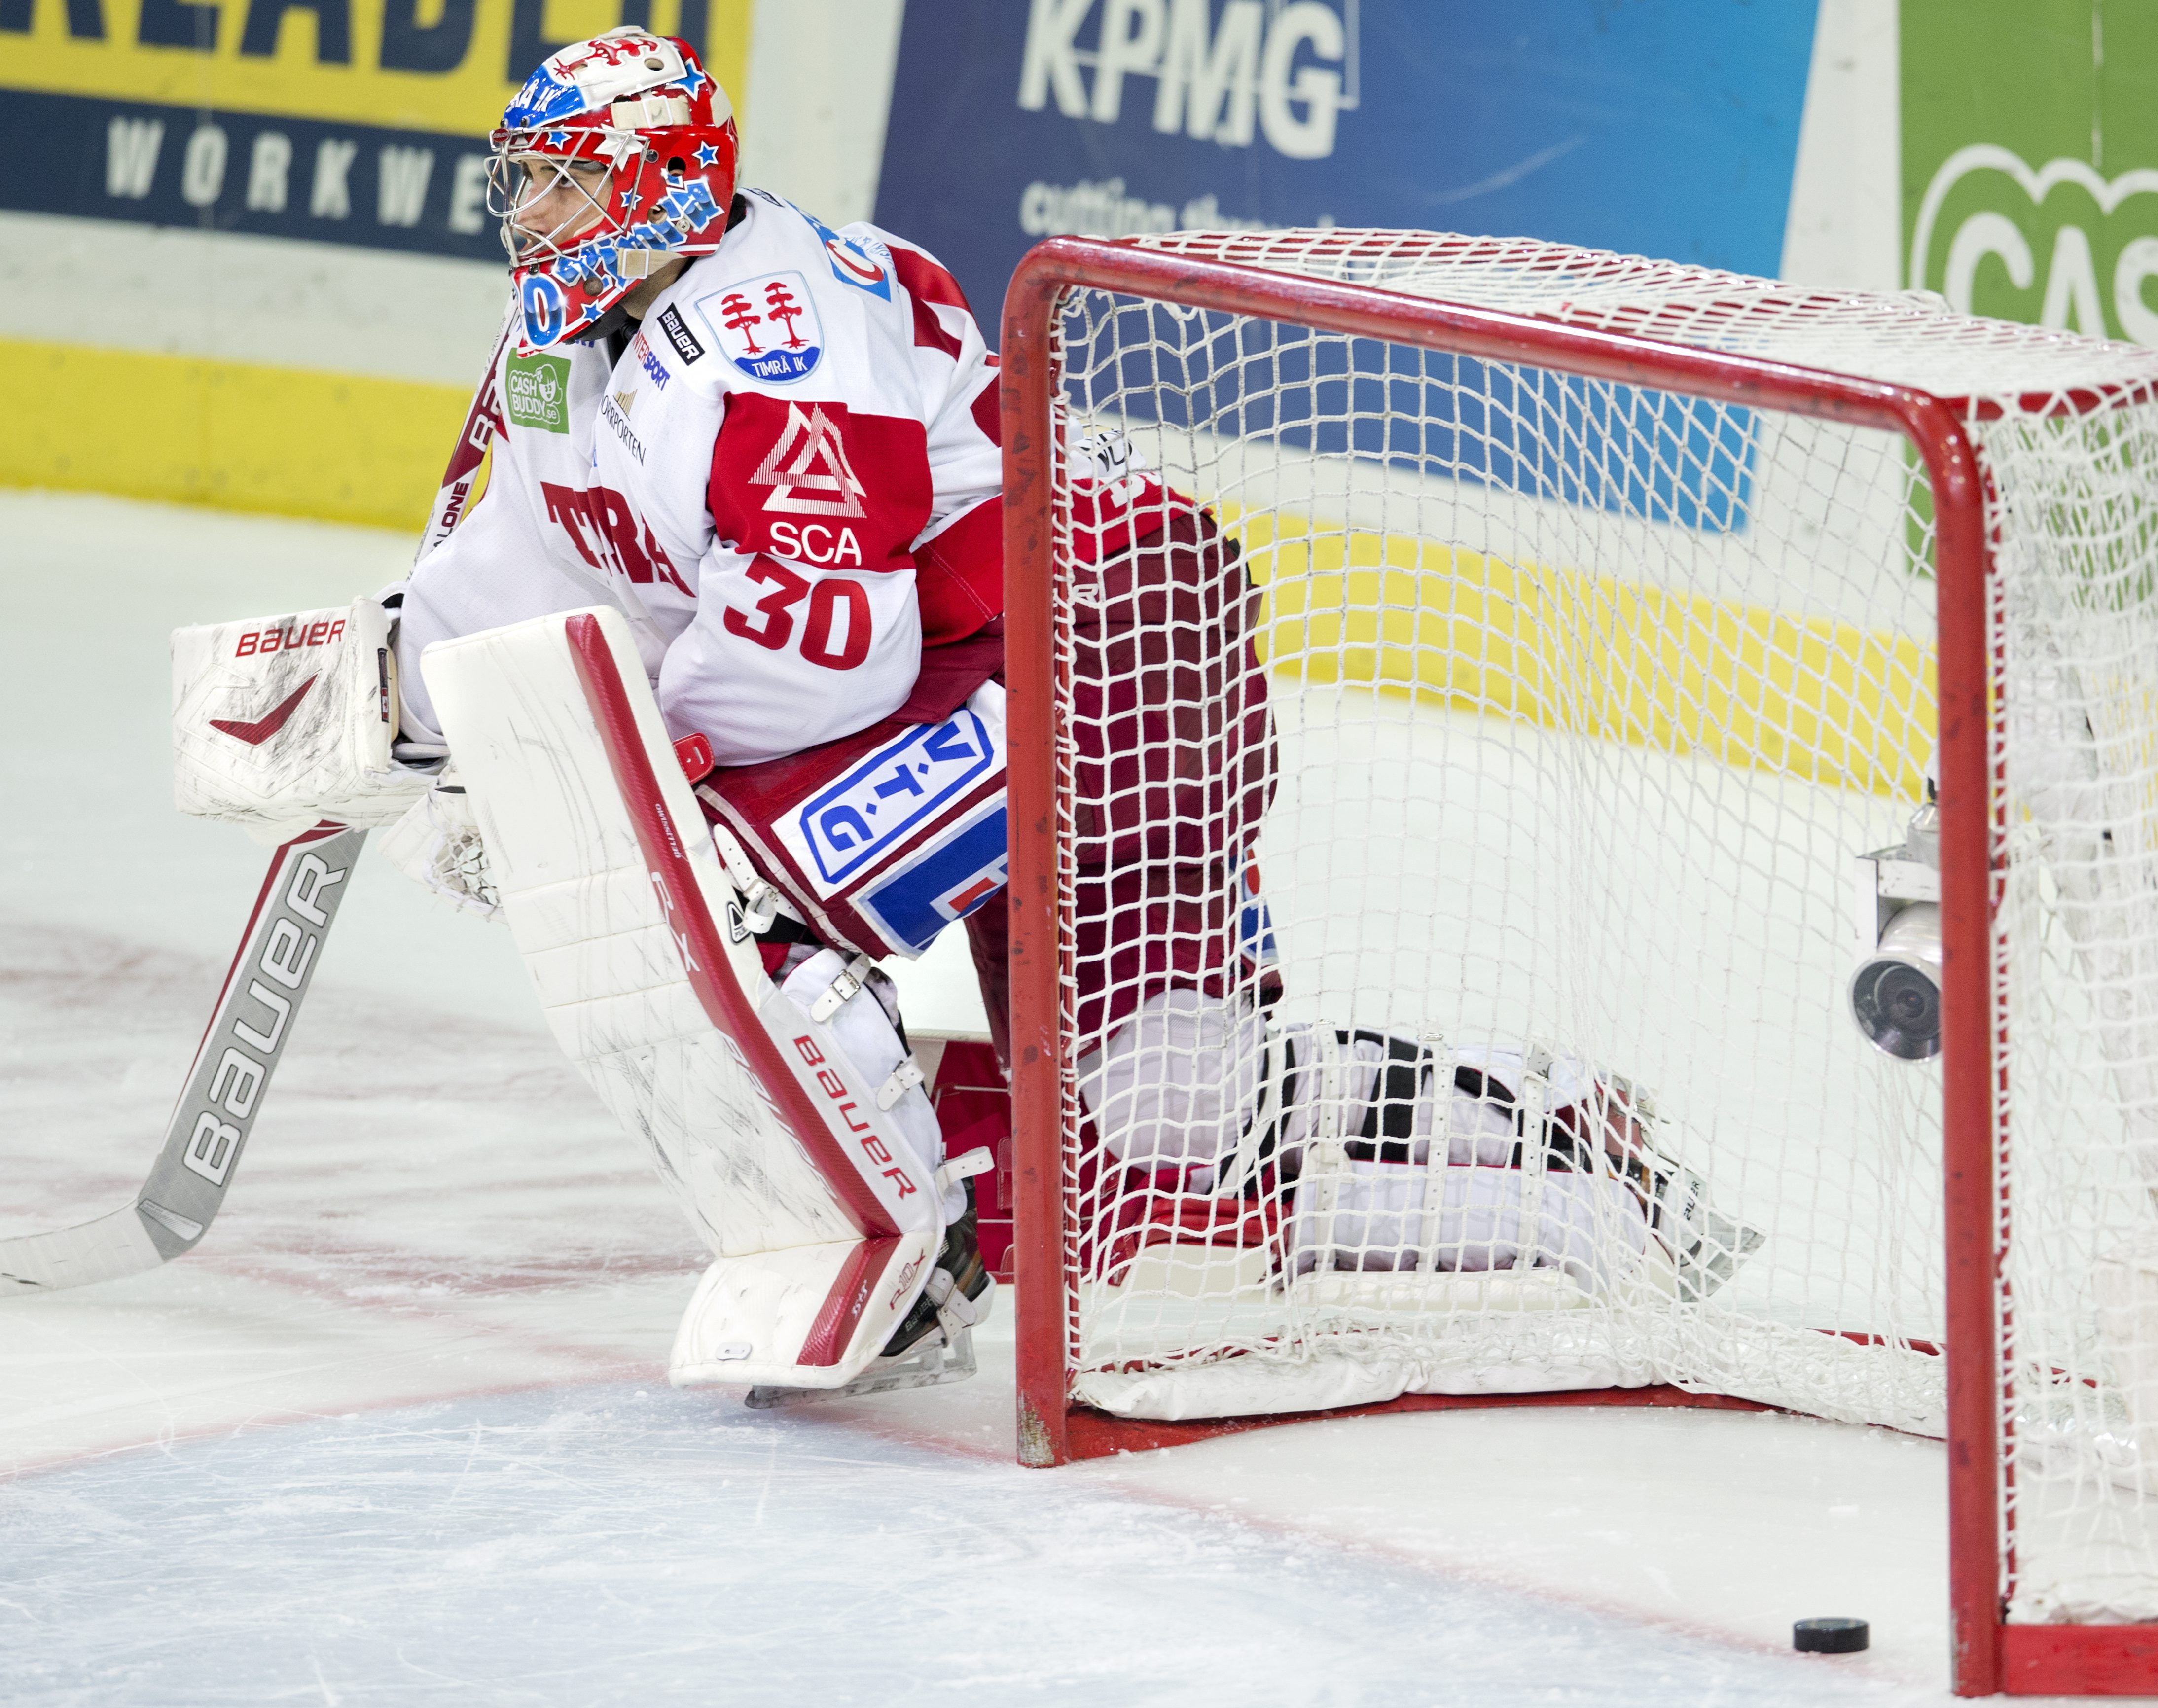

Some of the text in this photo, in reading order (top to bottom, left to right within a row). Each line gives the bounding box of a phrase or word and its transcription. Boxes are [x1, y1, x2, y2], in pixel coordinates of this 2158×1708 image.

[532, 86, 562, 112] IK
[1017, 0, 1346, 160] KPMG
[662, 311, 699, 359] BAUER
[511, 375, 537, 397] CASH
[751, 354, 808, 378] TIMRÅ IK
[512, 393, 545, 417] BUDDY
[600, 394, 646, 467] ORRPORTEN
[769, 521, 862, 566] SCA
[723, 552, 872, 671] 30
[235, 619, 346, 658] BAUER
[182, 853, 347, 1187] BAUER
[793, 1035, 917, 1199] BAUER
